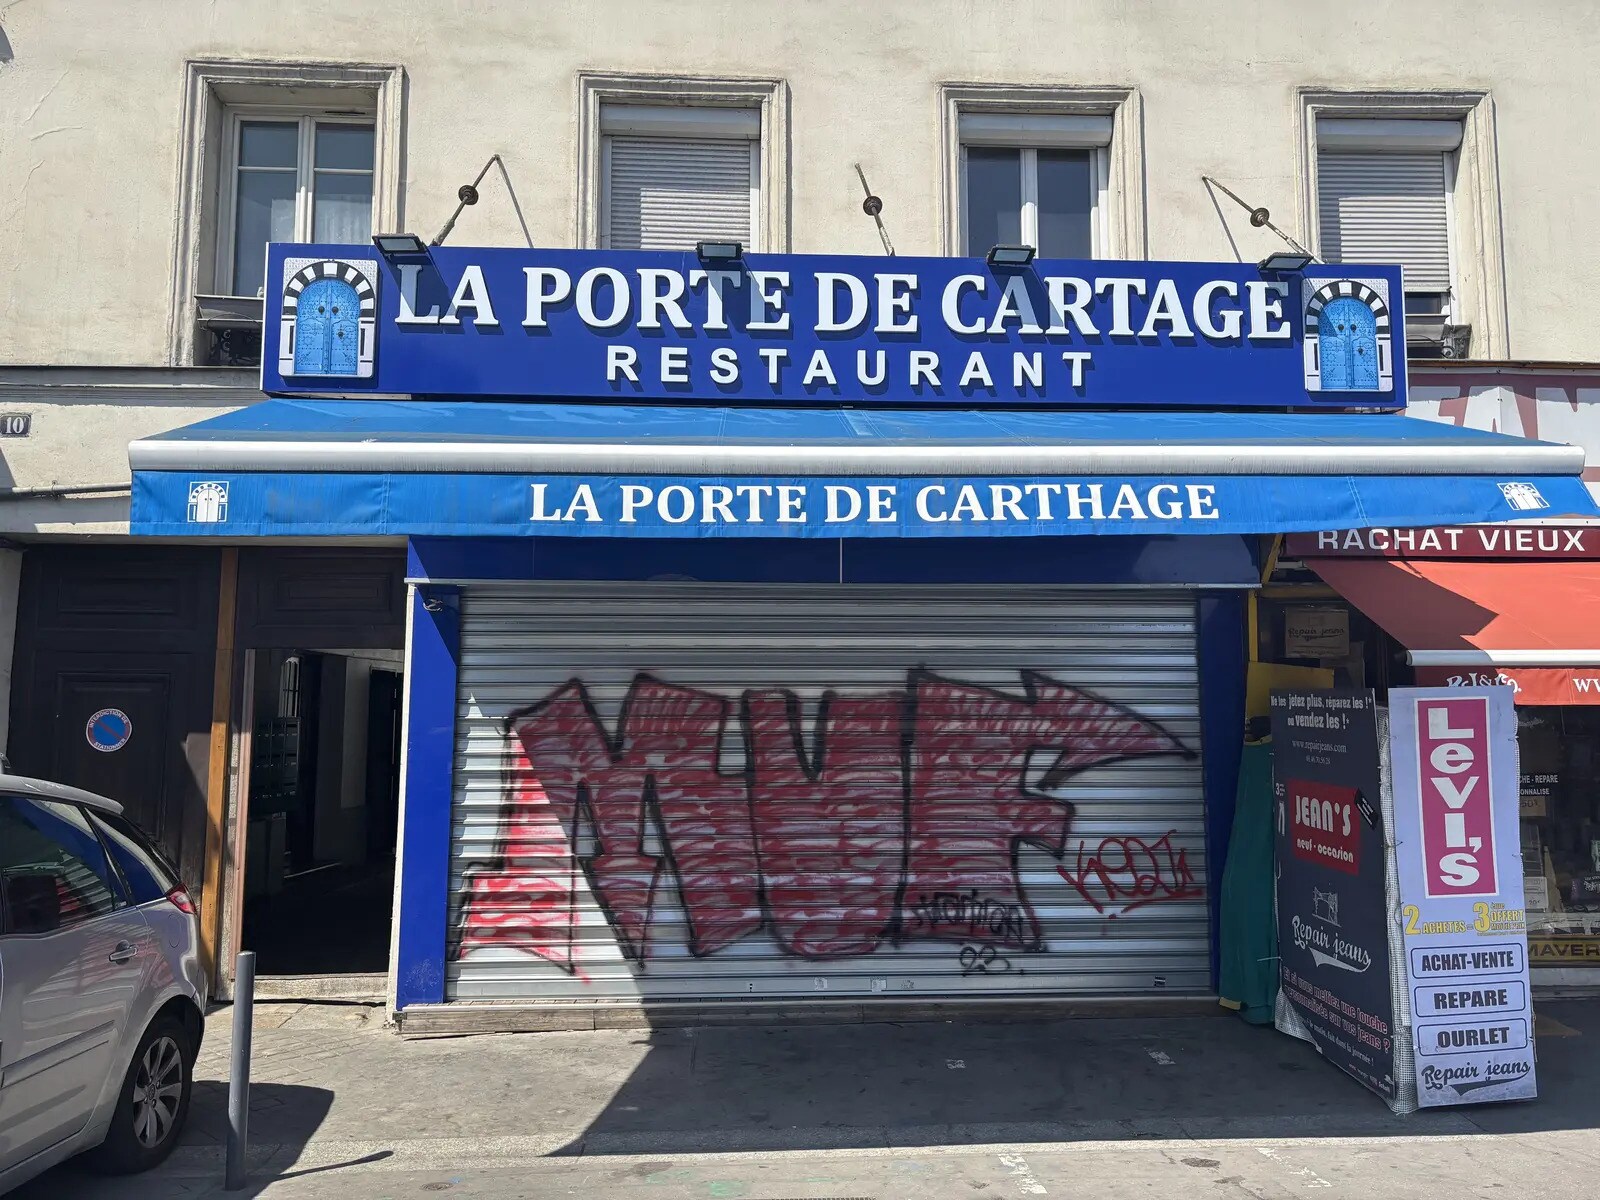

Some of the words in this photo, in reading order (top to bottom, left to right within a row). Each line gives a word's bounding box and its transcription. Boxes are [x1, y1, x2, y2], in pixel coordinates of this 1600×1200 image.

[395, 264, 499, 325] LA
[522, 267, 790, 330] PORTE
[813, 272, 918, 332] DE
[941, 274, 1291, 339] CARTAGE
[606, 345, 1092, 388] RESTAURANT
[6, 416, 25, 434] 10
[530, 483, 603, 522] LA
[619, 485, 807, 523] PORTE
[824, 485, 897, 522] DE
[916, 484, 1219, 523] CARTHAGE
[1318, 528, 1463, 550] RACHAT
[1478, 529, 1585, 551] VIEUX
[1289, 694, 1305, 709] jetez
[1307, 694, 1324, 709] plus,
[1352, 697, 1364, 709] les
[1295, 712, 1324, 728] vendez
[1326, 713, 1340, 729] les
[1296, 795, 1351, 837] JEAN'S
[1297, 838, 1312, 849] neuf
[1318, 843, 1354, 863] occasion
[1403, 904, 1421, 935] 2
[1473, 901, 1490, 933] 3
[1491, 909, 1524, 922] OFFERT
[1292, 915, 1330, 949] Repair
[1333, 933, 1371, 965] jeans
[1421, 950, 1514, 972] ACHAT-VENTE
[1433, 988, 1508, 1010] REPARE
[1357, 1008, 1388, 1034] touche
[1357, 1024, 1381, 1050] jeans
[1383, 1038, 1391, 1053] ?
[1437, 1026, 1510, 1049] OURLET
[1421, 1062, 1479, 1090] Repair
[1484, 1060, 1531, 1081] jeans
